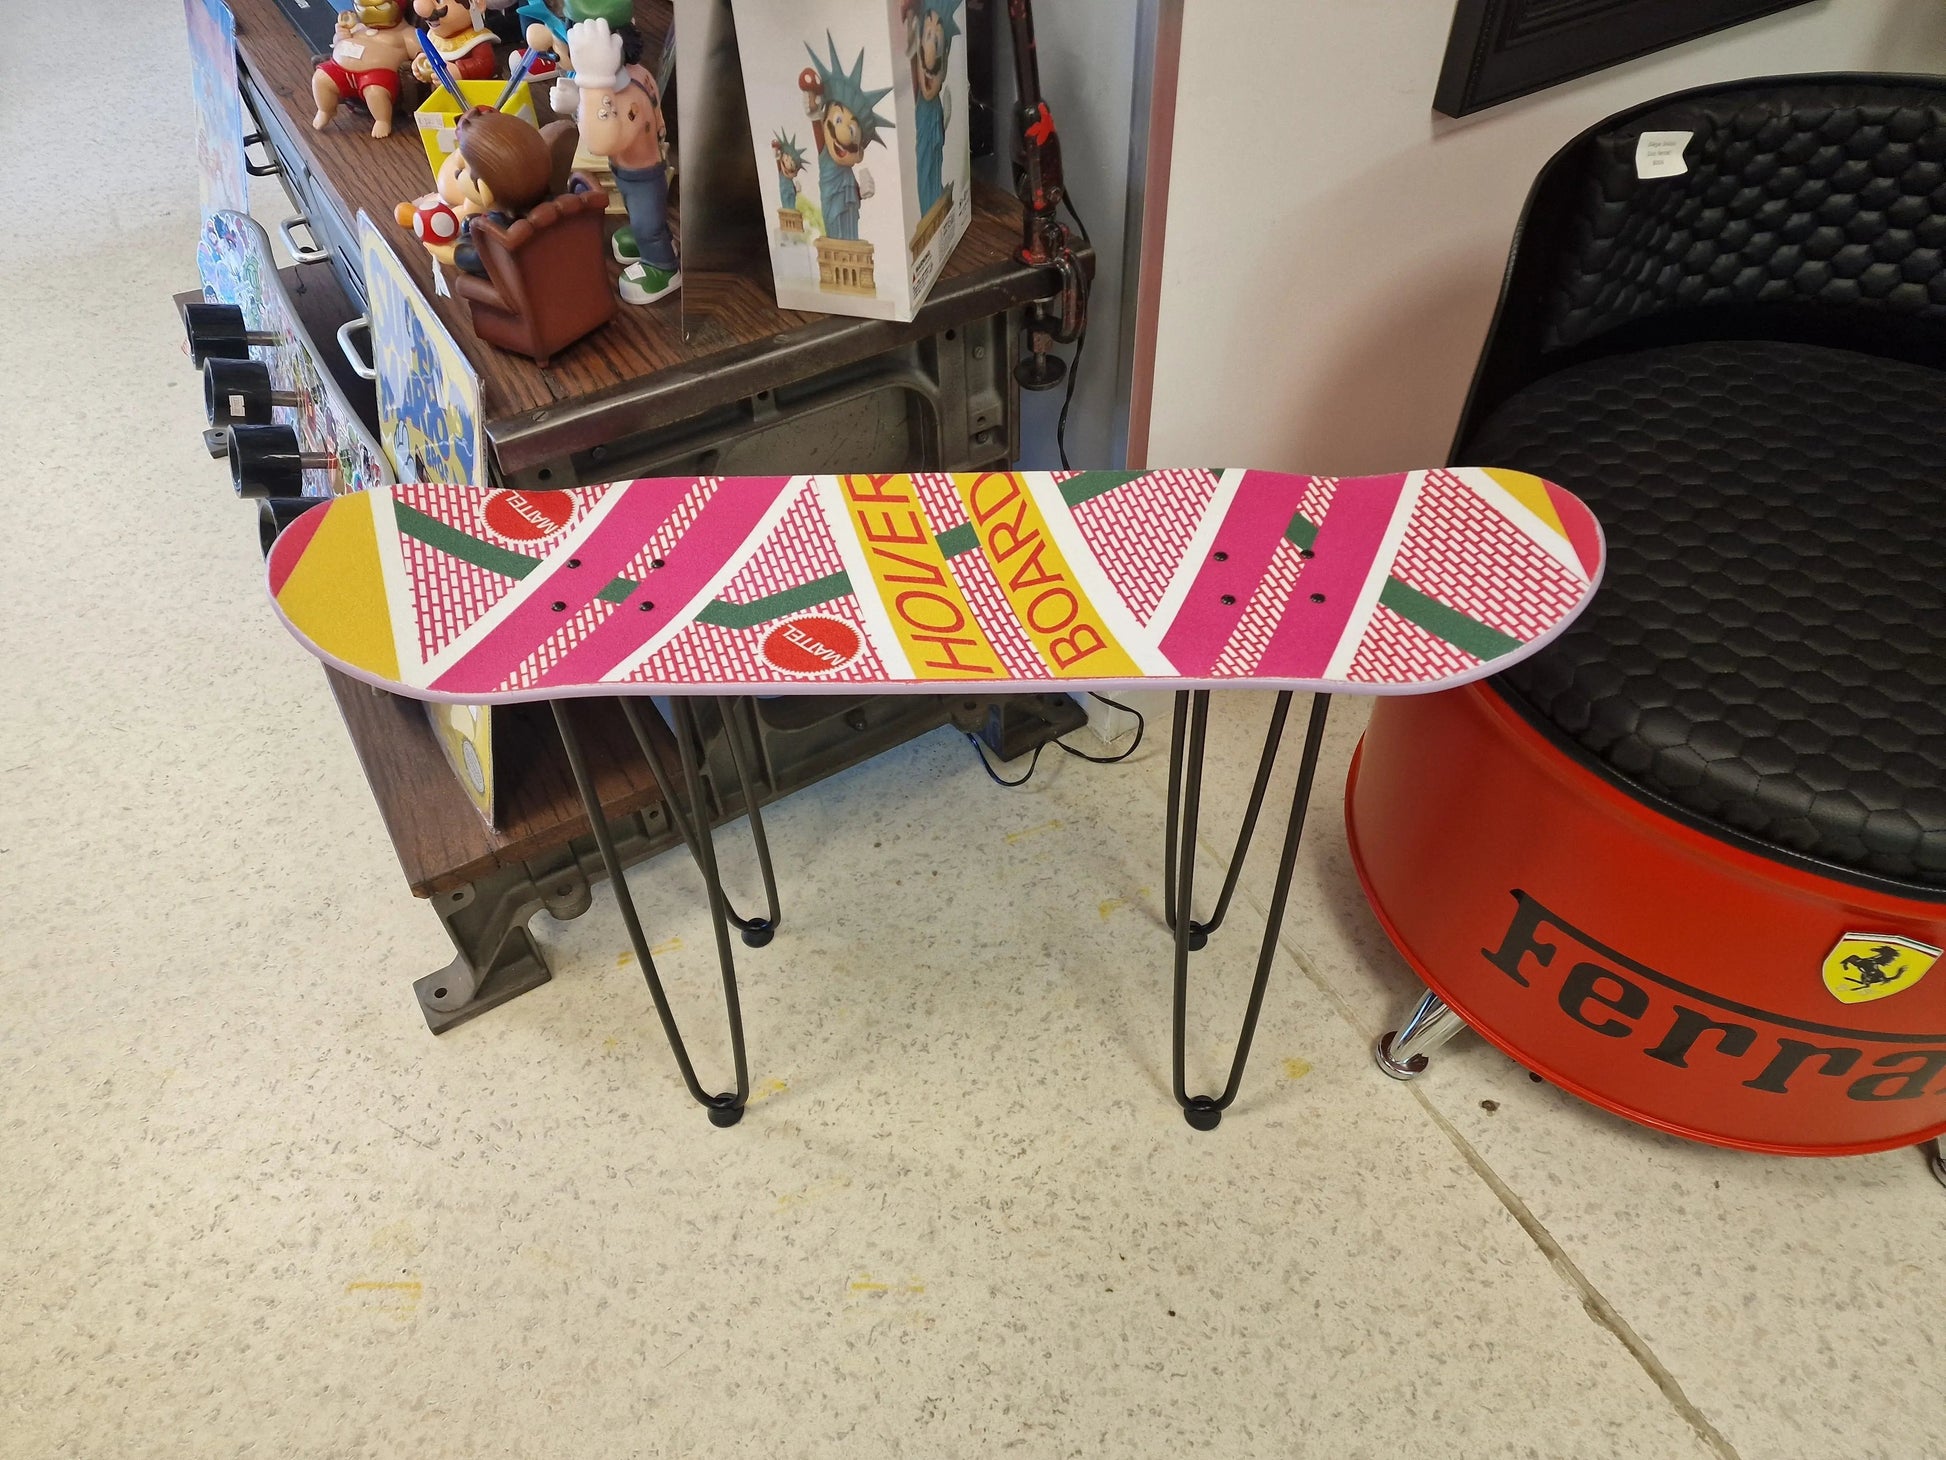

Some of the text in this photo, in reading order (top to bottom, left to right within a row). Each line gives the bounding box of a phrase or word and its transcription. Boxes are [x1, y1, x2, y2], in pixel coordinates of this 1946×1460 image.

[505, 489, 560, 535] MATTEL
[844, 474, 994, 674] HOVER
[970, 472, 1108, 670] BOARD
[782, 623, 847, 667] MATTEL
[1481, 888, 1946, 1101] Ferra
